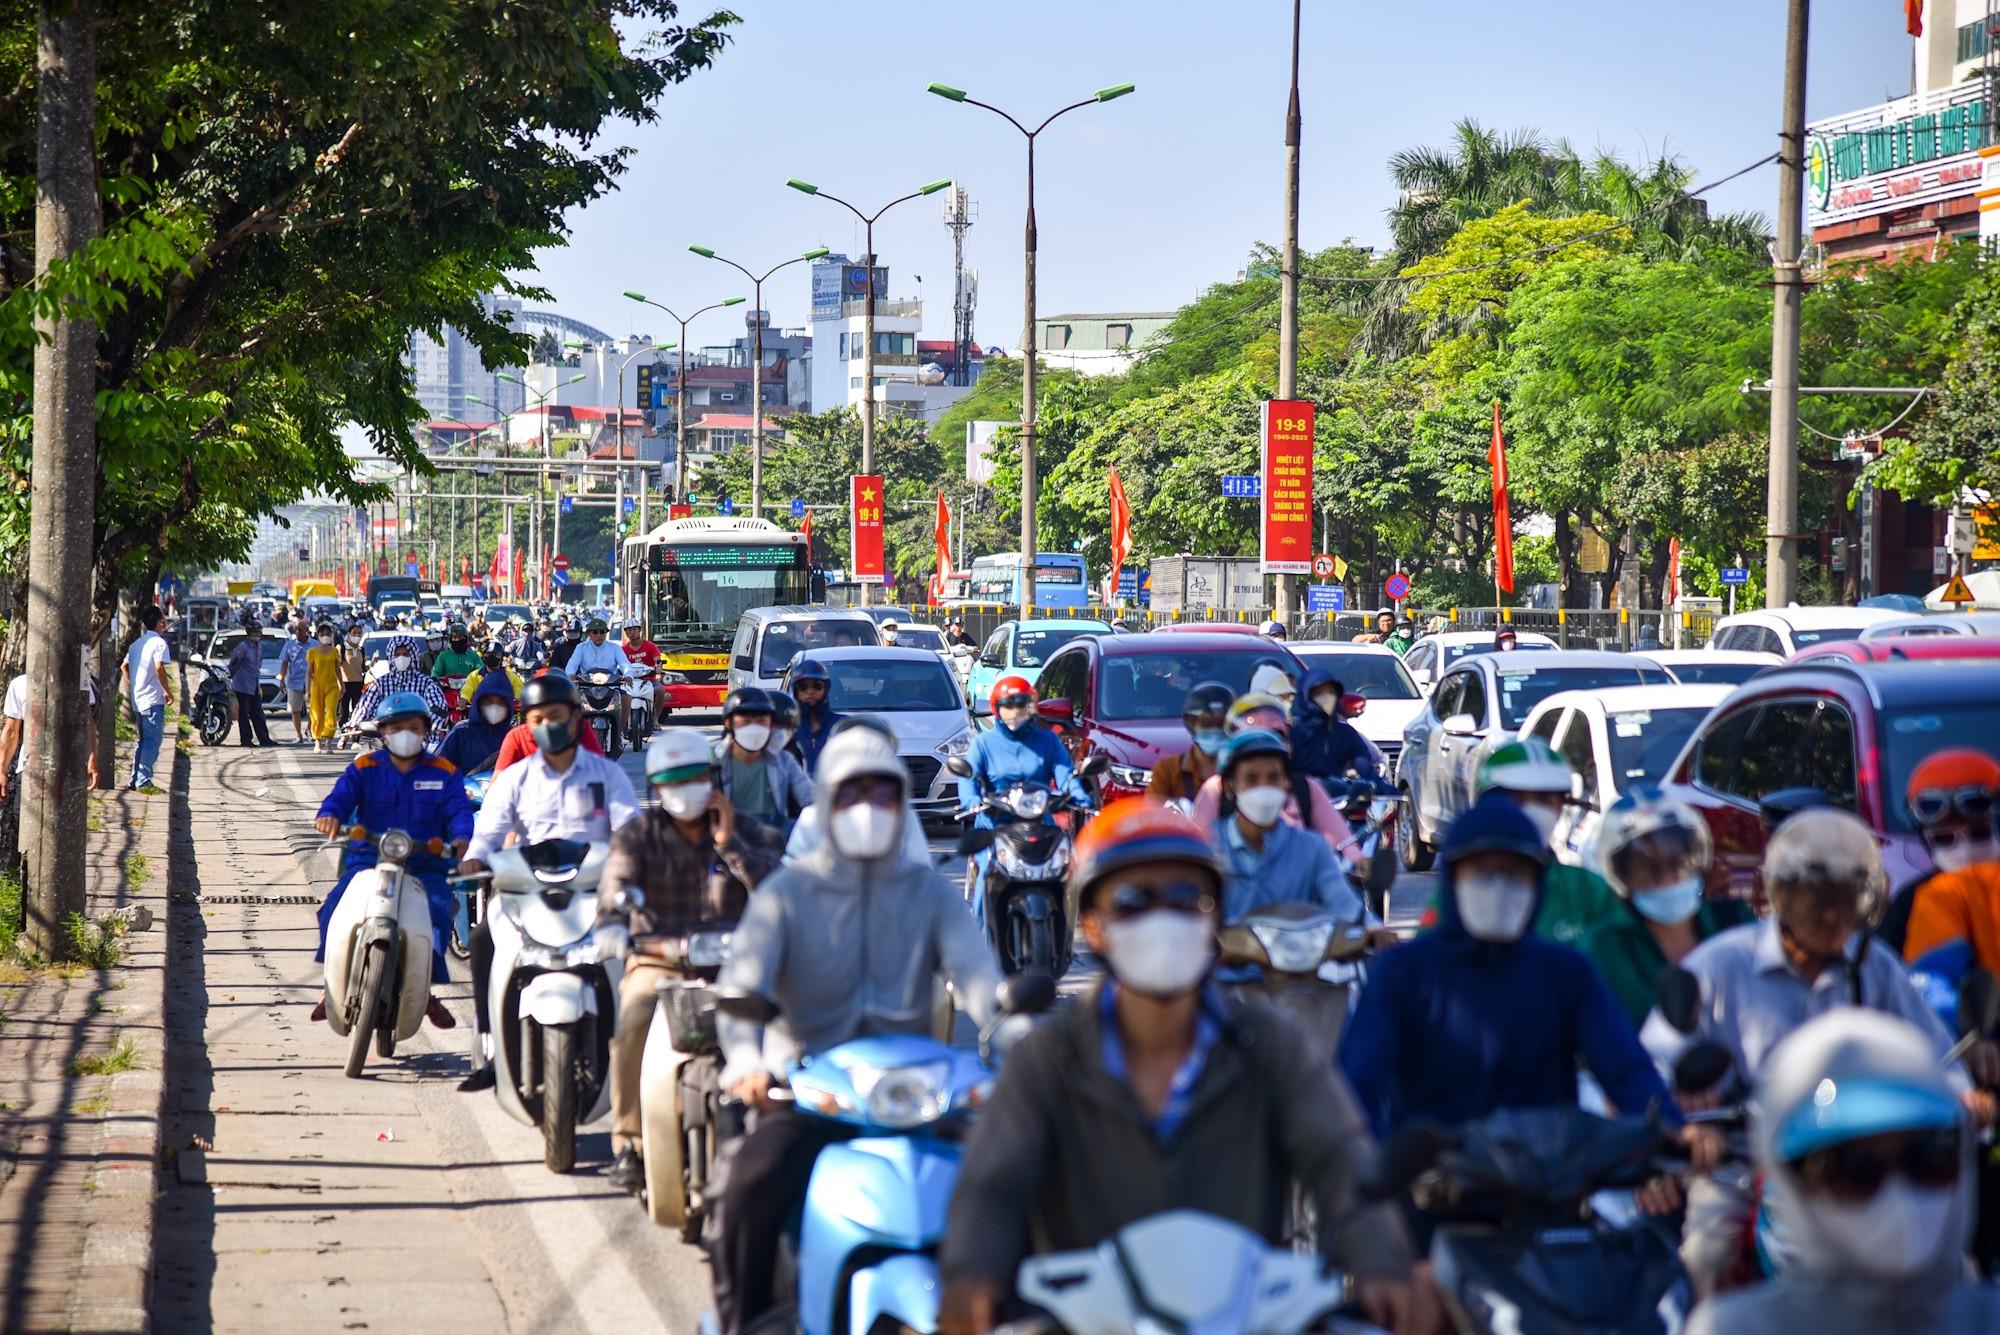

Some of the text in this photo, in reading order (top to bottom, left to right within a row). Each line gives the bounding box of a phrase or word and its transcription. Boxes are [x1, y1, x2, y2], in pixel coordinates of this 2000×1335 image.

[1276, 418, 1306, 431] 19-8
[858, 507, 879, 521] 19-8
[722, 575, 735, 585] 16
[705, 657, 719, 665] BUS
